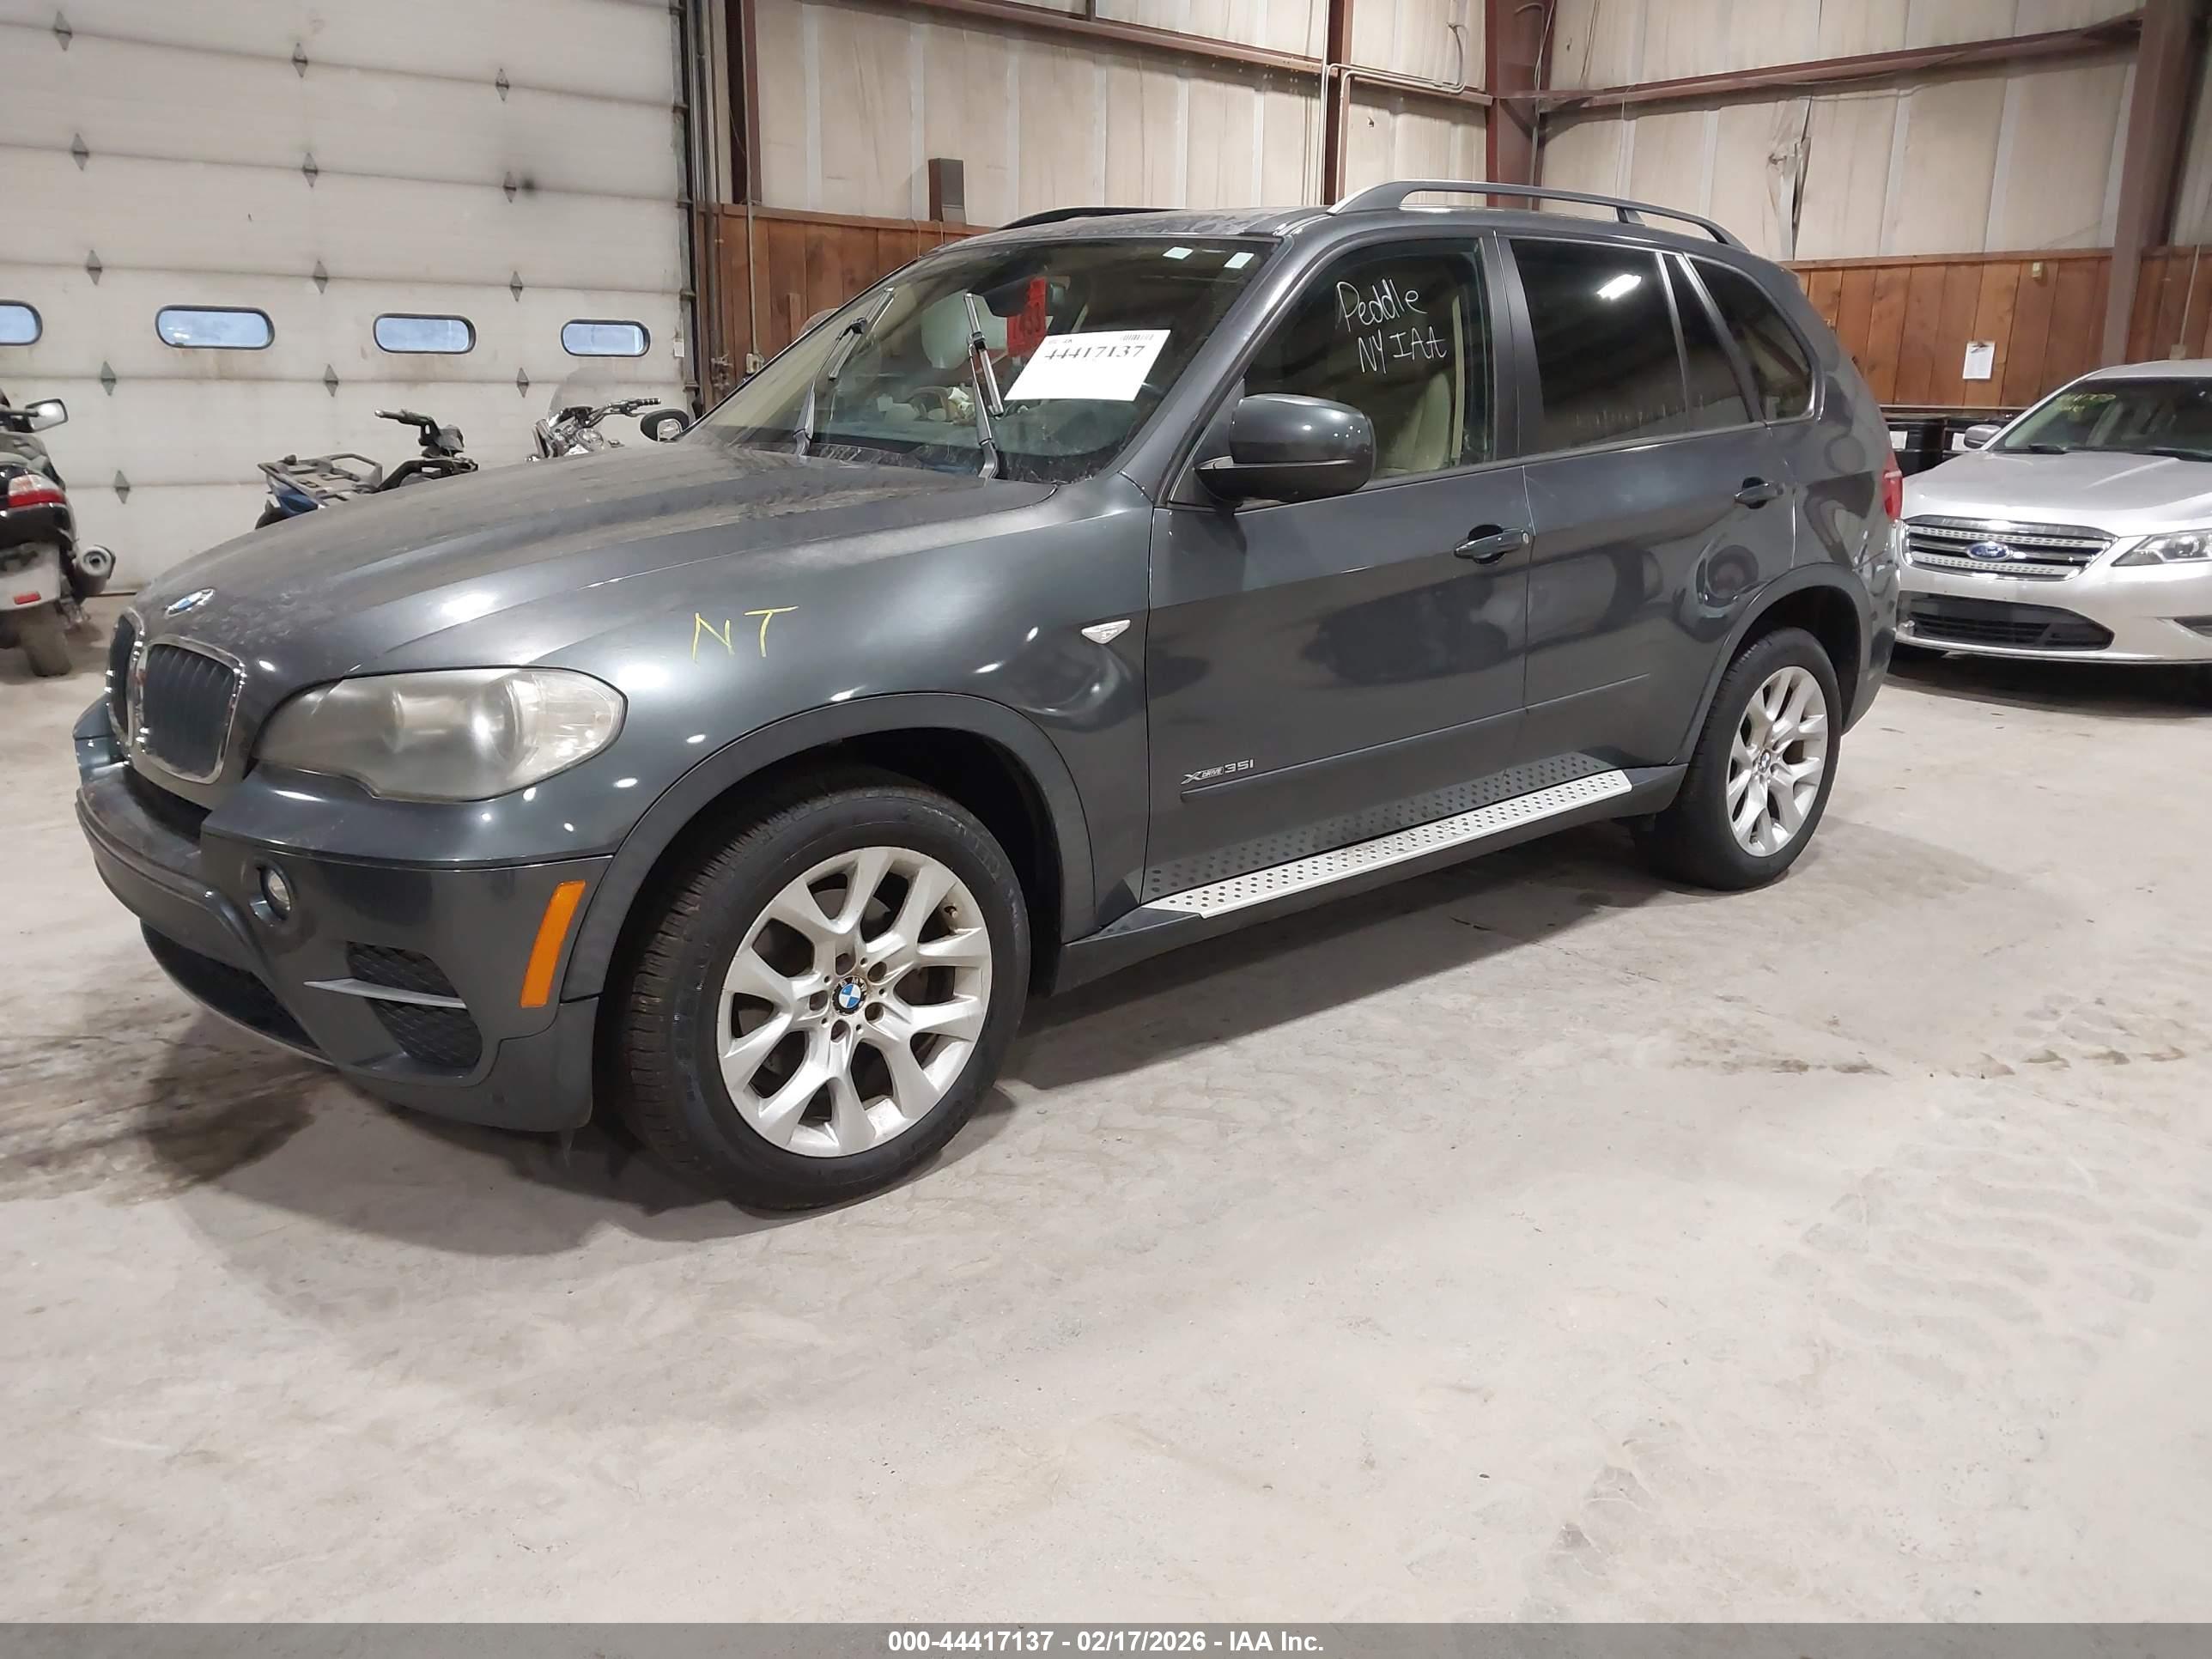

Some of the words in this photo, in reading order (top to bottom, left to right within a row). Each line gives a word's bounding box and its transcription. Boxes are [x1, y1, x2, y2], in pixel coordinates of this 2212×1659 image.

[1334, 277, 1428, 333] Peddle
[1044, 345, 1146, 361] 44417137
[1358, 329, 1387, 374] NY
